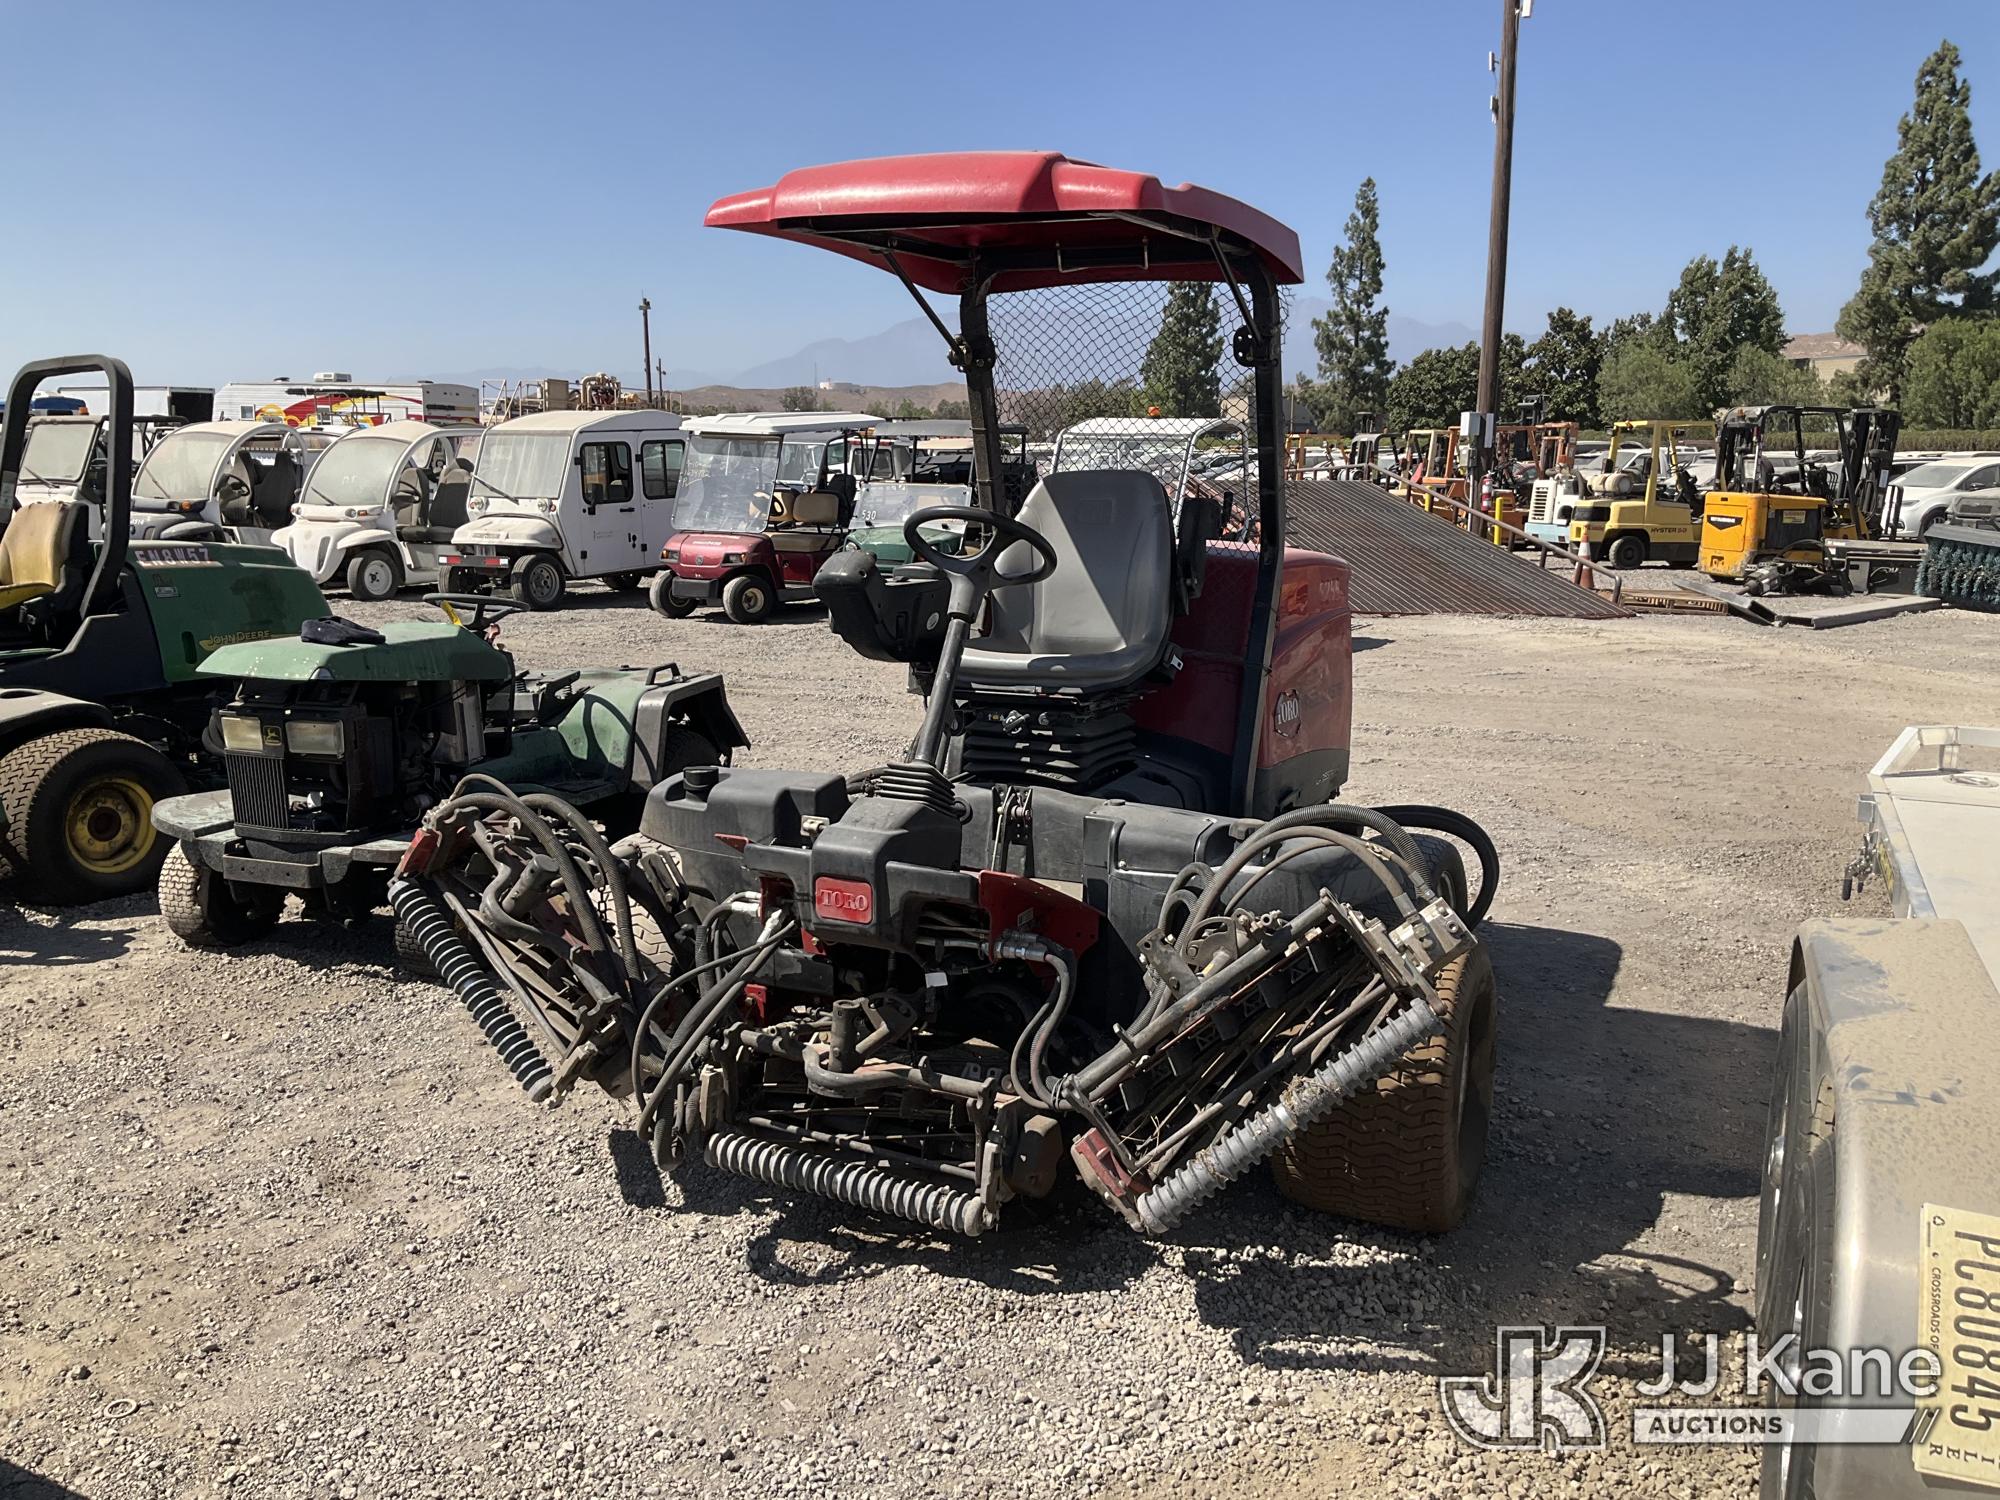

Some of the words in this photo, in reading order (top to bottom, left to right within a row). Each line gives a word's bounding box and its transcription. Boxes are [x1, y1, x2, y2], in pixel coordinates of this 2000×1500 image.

[862, 509, 877, 520] 530
[207, 633, 237, 646] JOHN
[238, 630, 271, 641] DEERE
[820, 889, 868, 911] TORO
[1930, 1267, 1941, 1334] CROSSROADS
[1950, 1231, 2000, 1431] PC80845
[1930, 1335, 1940, 1349] OF
